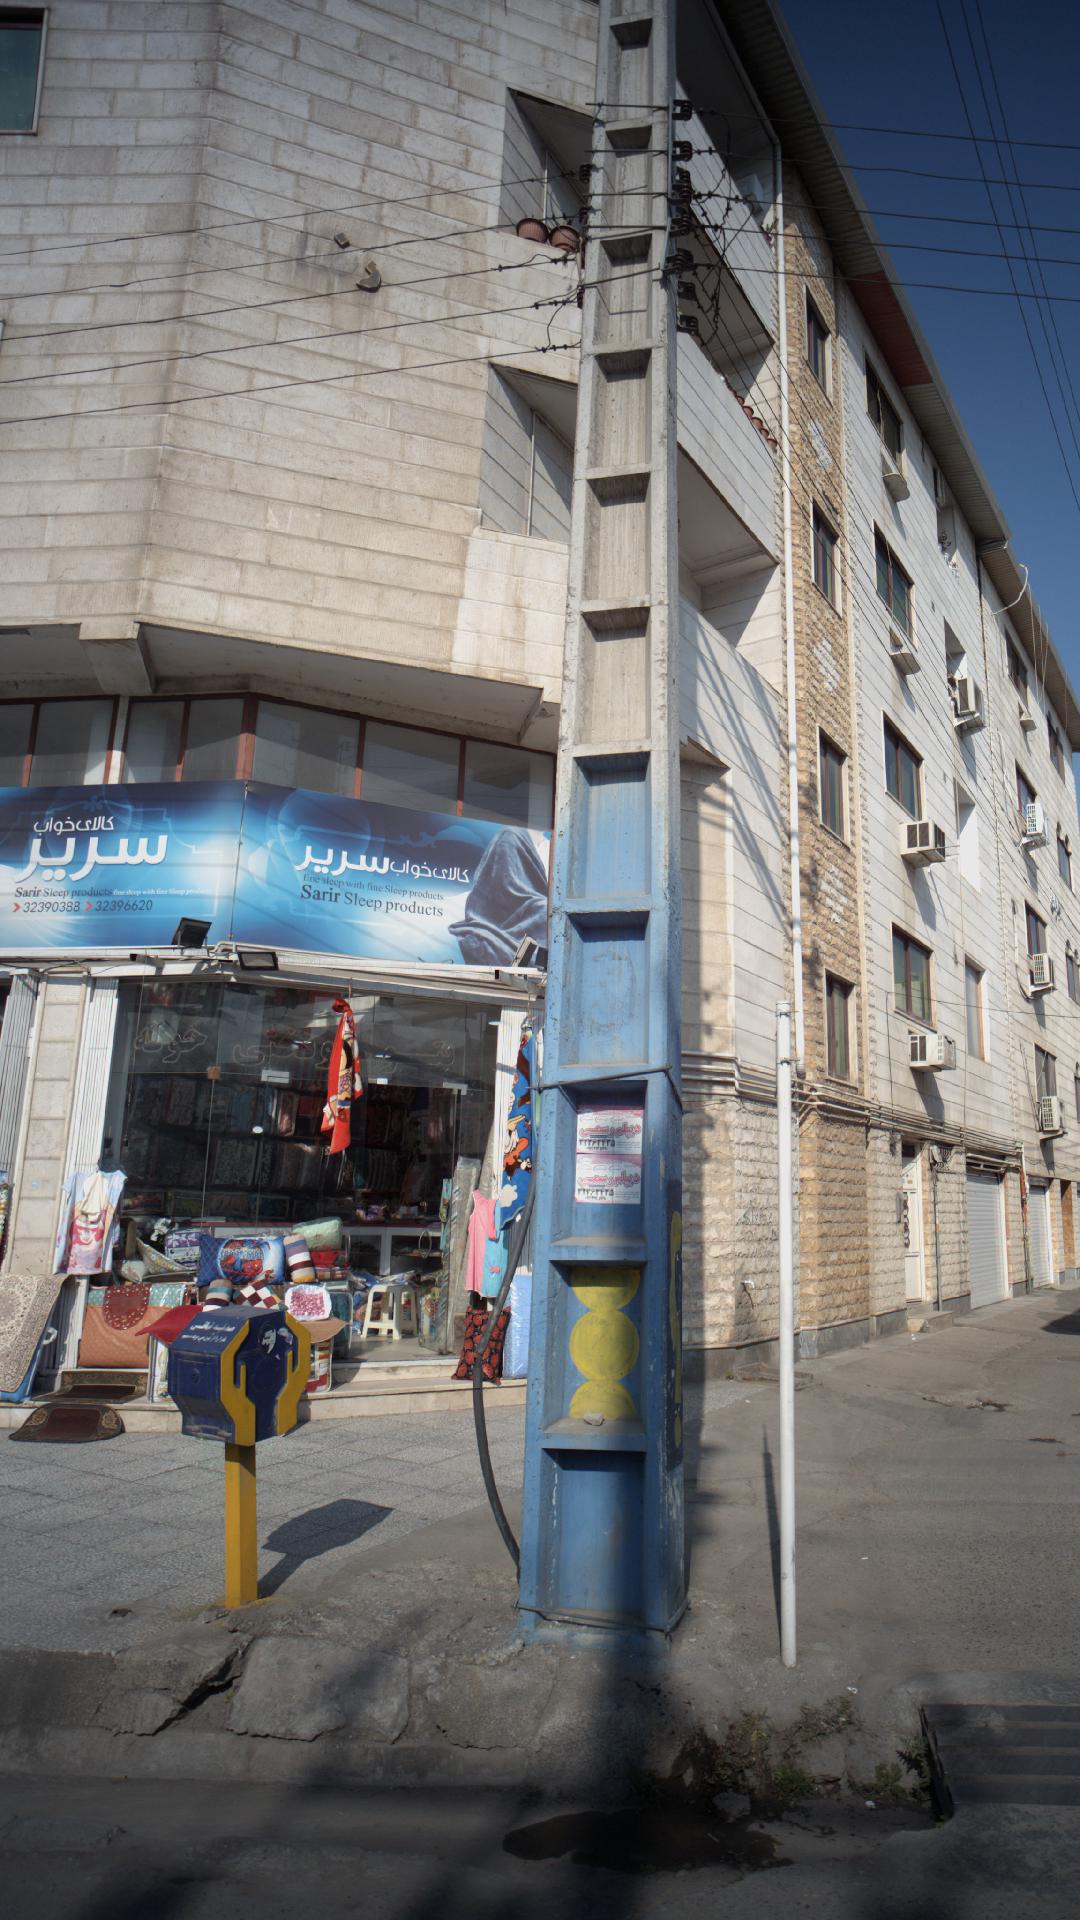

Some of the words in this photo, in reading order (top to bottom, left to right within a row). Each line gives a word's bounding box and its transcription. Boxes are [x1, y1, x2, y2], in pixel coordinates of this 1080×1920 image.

[33, 816, 77, 836] خواب
[77, 815, 114, 832] کالای
[15, 834, 168, 883] سریر
[294, 844, 390, 876] سریر
[389, 858, 433, 880] خواب
[433, 863, 471, 884] کالای
[14, 886, 42, 899] Sarir
[43, 887, 69, 900] Sleep
[71, 886, 113, 900] products
[303, 873, 320, 884] fine
[321, 874, 344, 888] sleep
[346, 879, 365, 890] with
[367, 881, 384, 892] fine
[384, 885, 408, 897] Sleep
[409, 888, 444, 901] products
[22, 900, 81, 913] 32390388
[94, 899, 153, 912] 32396620
[300, 884, 340, 903] Sarir
[343, 891, 382, 910] Sleep
[385, 899, 444, 917] products
